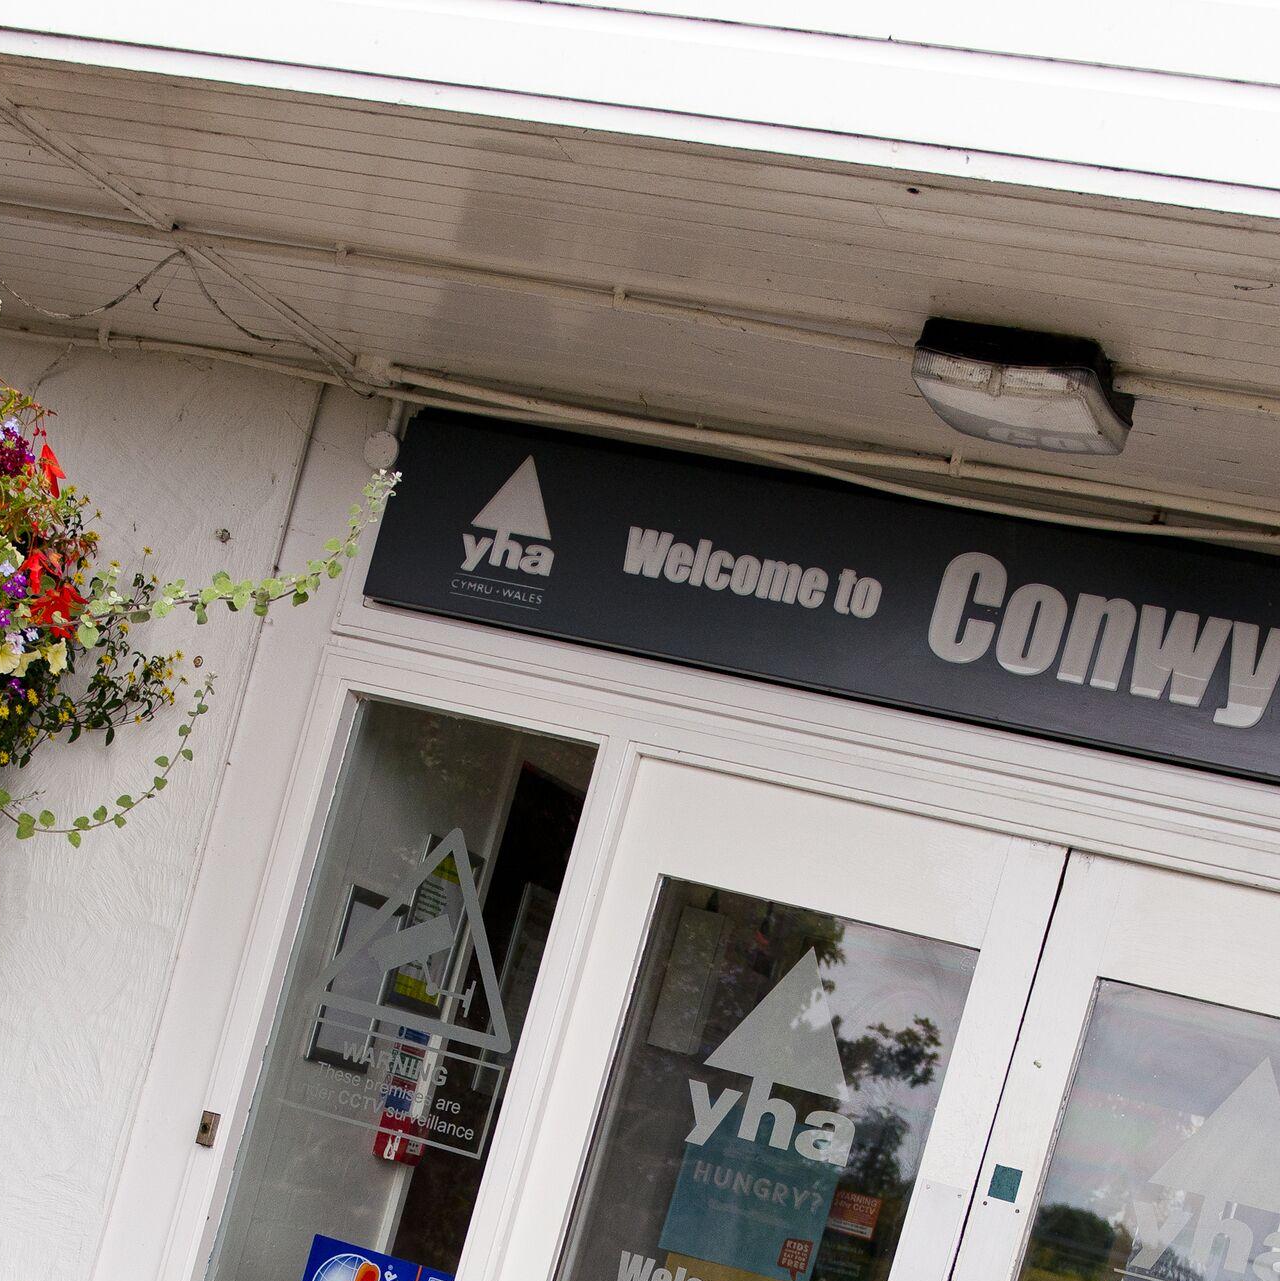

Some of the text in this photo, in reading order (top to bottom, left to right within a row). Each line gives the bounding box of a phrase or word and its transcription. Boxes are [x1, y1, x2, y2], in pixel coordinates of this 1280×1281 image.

[460, 528, 555, 577] yha
[622, 524, 883, 620] Welcome to
[451, 578, 543, 605] CYMRU WALES
[319, 1061, 361, 1086] These
[365, 1080, 432, 1107] premises
[436, 1098, 461, 1114] are
[343, 1041, 448, 1086] WARNING
[338, 1091, 385, 1114] CCTV
[385, 1107, 474, 1141] surveillance
[685, 1077, 856, 1167] yha
[781, 1258, 806, 1270] FREE
[786, 1240, 809, 1253] KIDS
